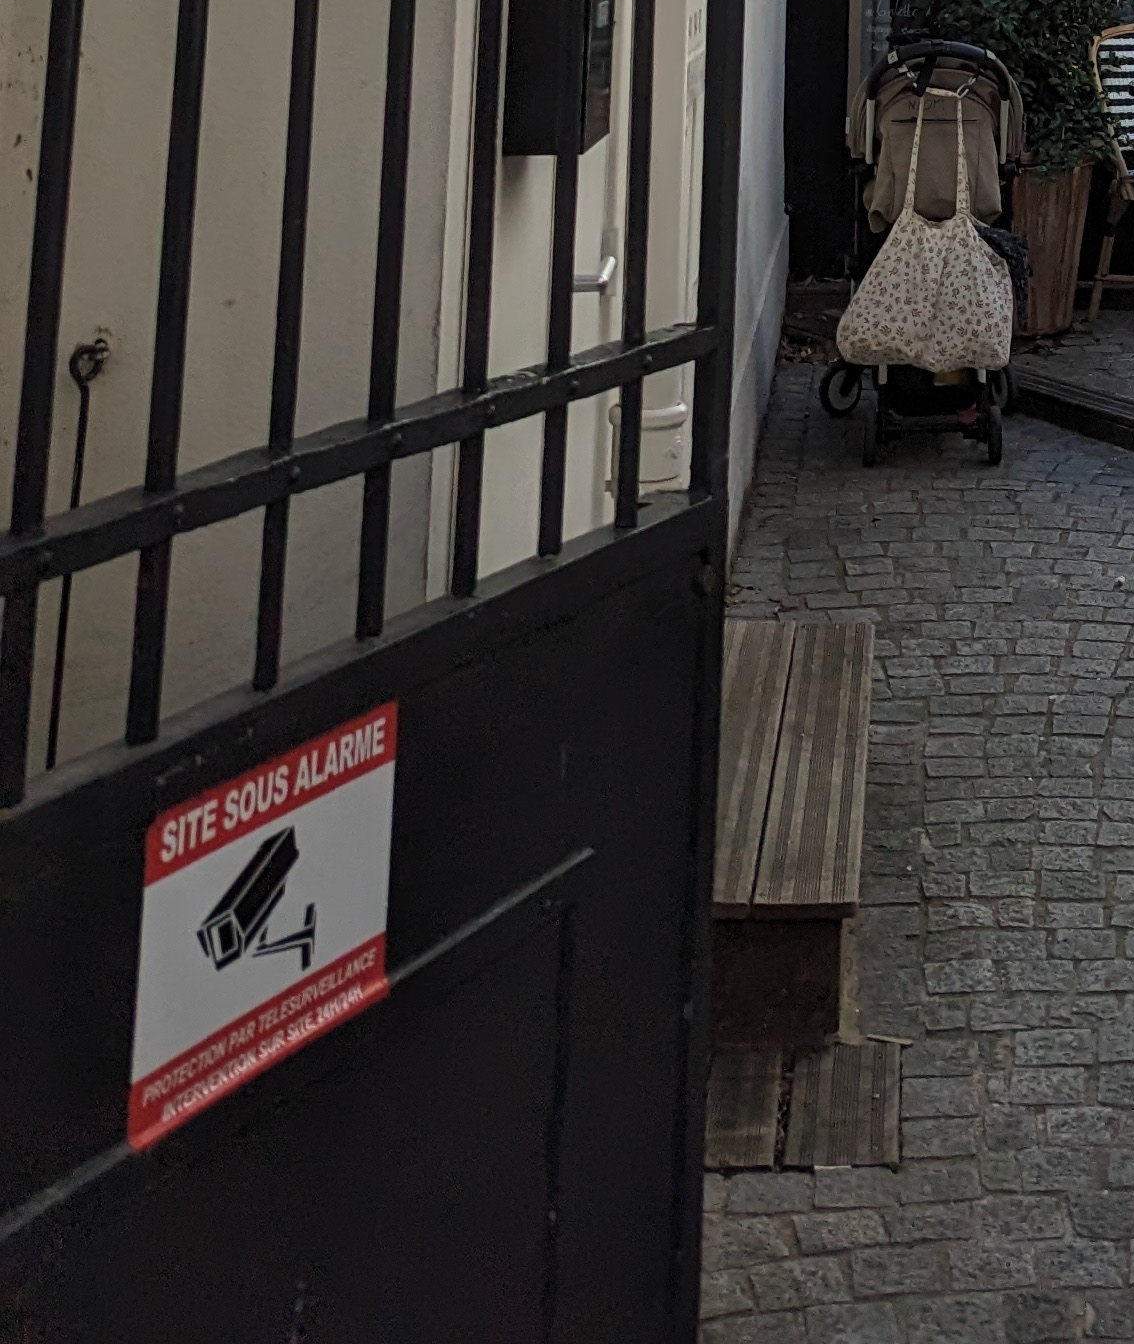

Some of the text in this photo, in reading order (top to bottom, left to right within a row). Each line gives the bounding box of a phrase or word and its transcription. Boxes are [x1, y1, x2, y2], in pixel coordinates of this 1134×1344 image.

[160, 717, 387, 863] SITE SOUS ALARME
[142, 1038, 228, 1108] PROTECTION
[228, 1020, 257, 1053] PAR
[161, 1047, 257, 1123] INTERVENTION
[258, 1029, 286, 1059] SUR
[286, 1011, 318, 1042] SITE
